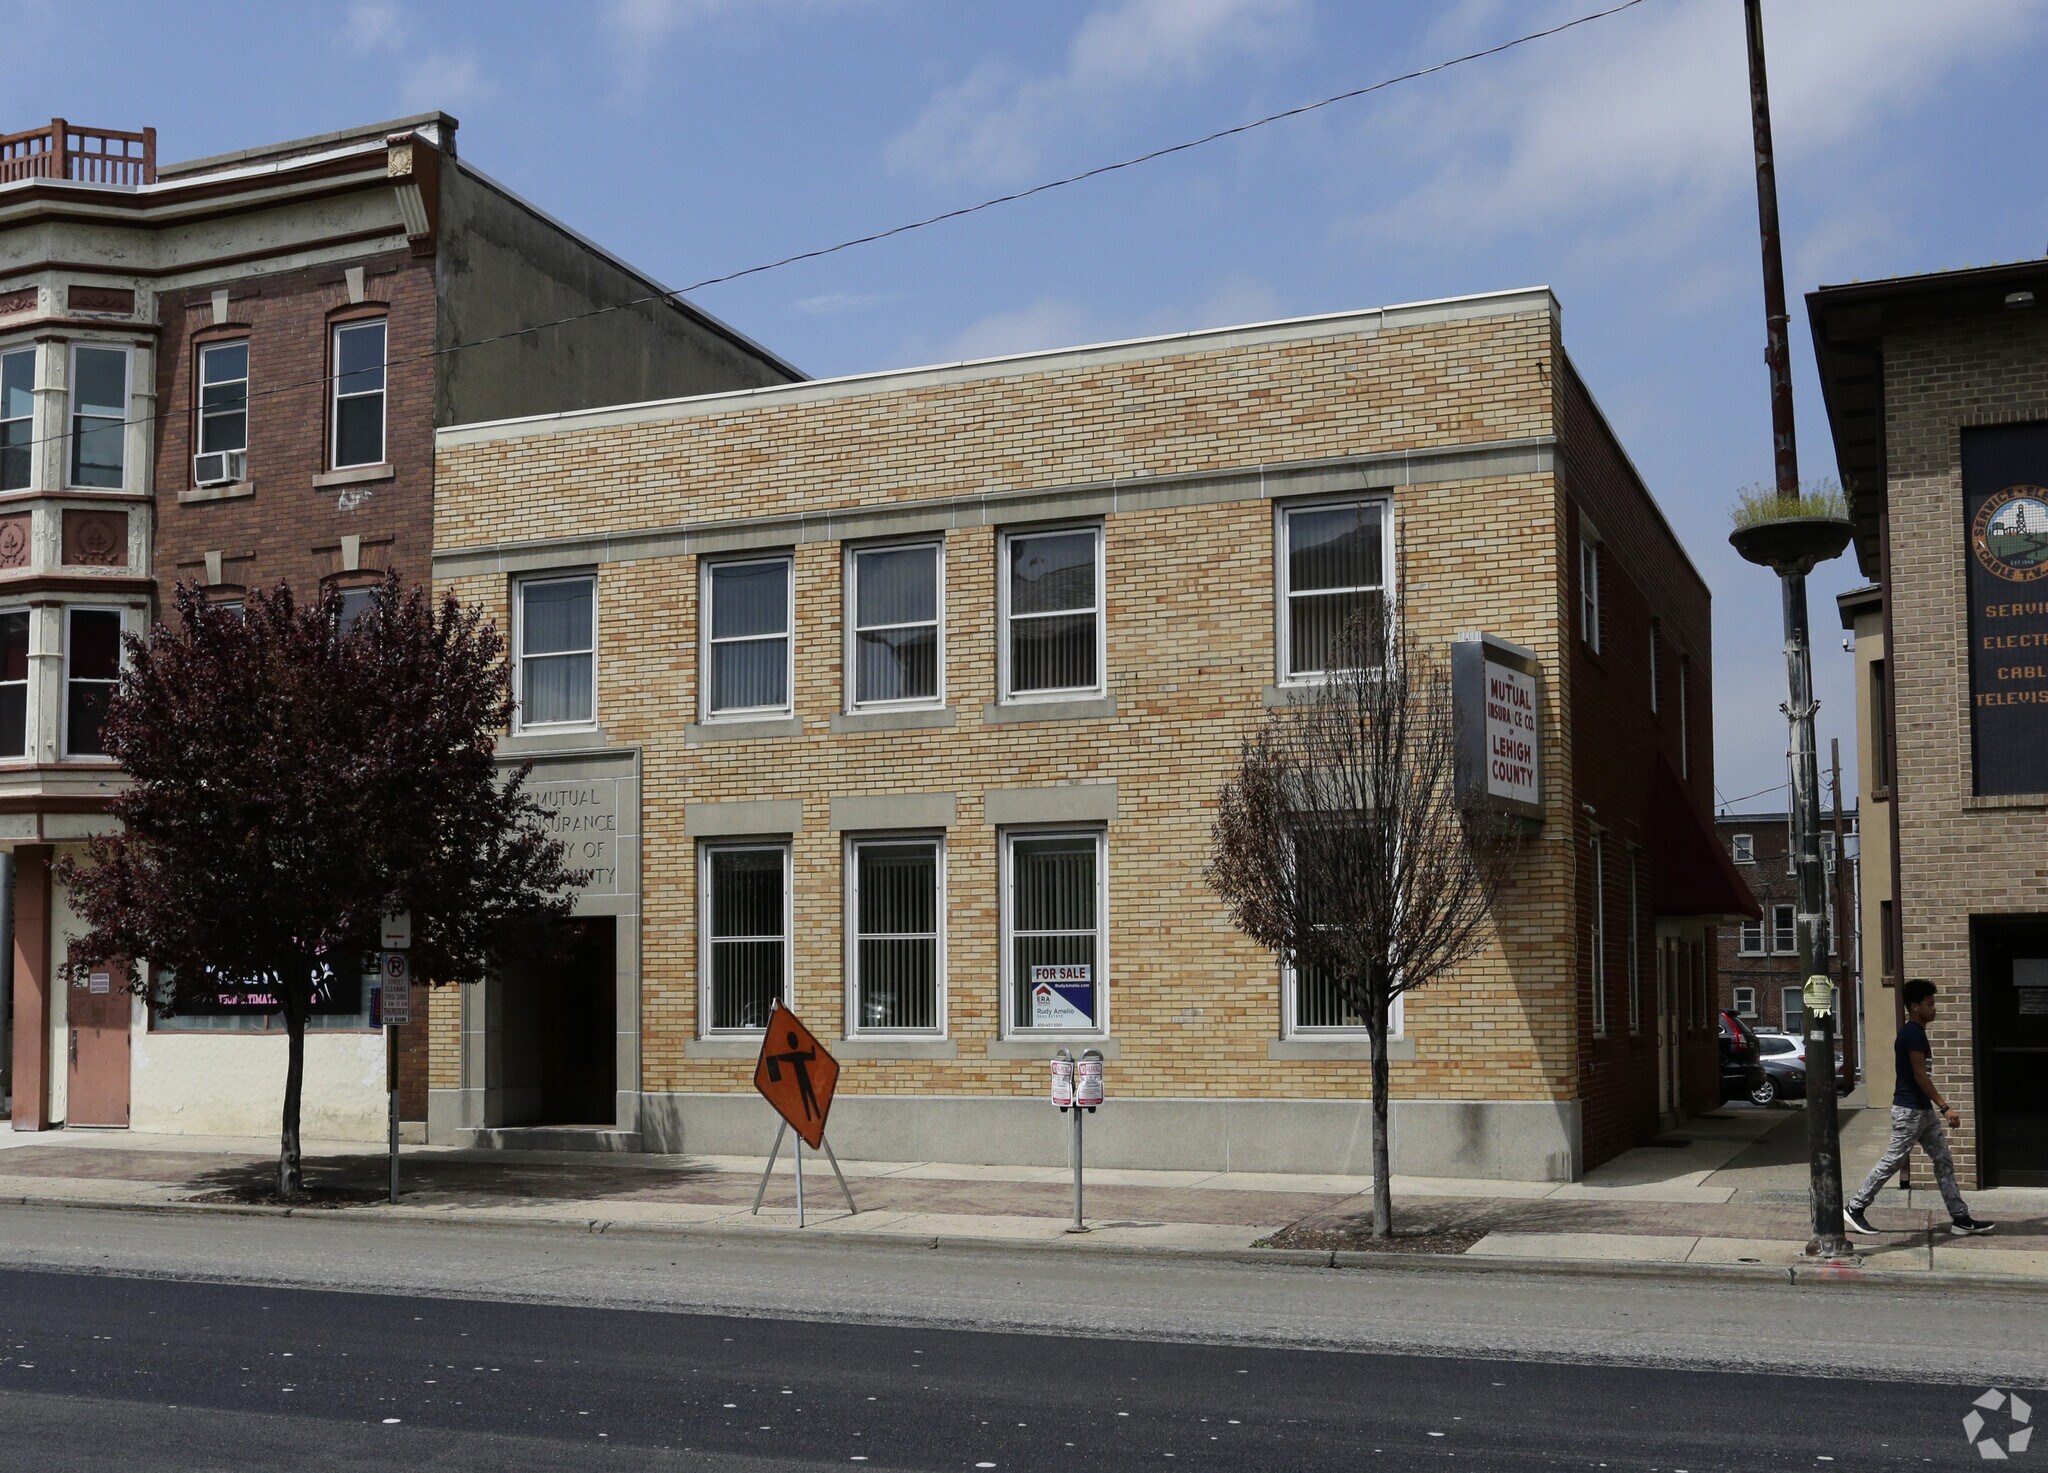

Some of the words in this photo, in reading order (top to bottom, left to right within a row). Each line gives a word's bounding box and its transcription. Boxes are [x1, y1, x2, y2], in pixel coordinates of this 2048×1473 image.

[1974, 488, 2015, 537] SERVICE
[1979, 550, 2014, 579] CABLE
[1986, 602, 2048, 617] SERVI
[1491, 677, 1531, 711] MUTUAL
[1524, 714, 1535, 732] CO.
[1493, 734, 1531, 764] LEHIGH
[1492, 759, 1533, 788] COUNTY
[536, 789, 600, 807] MUTUAL
[583, 842, 605, 859] OF
[1036, 968, 1056, 979] FOR
[1059, 967, 1086, 979] SALE
